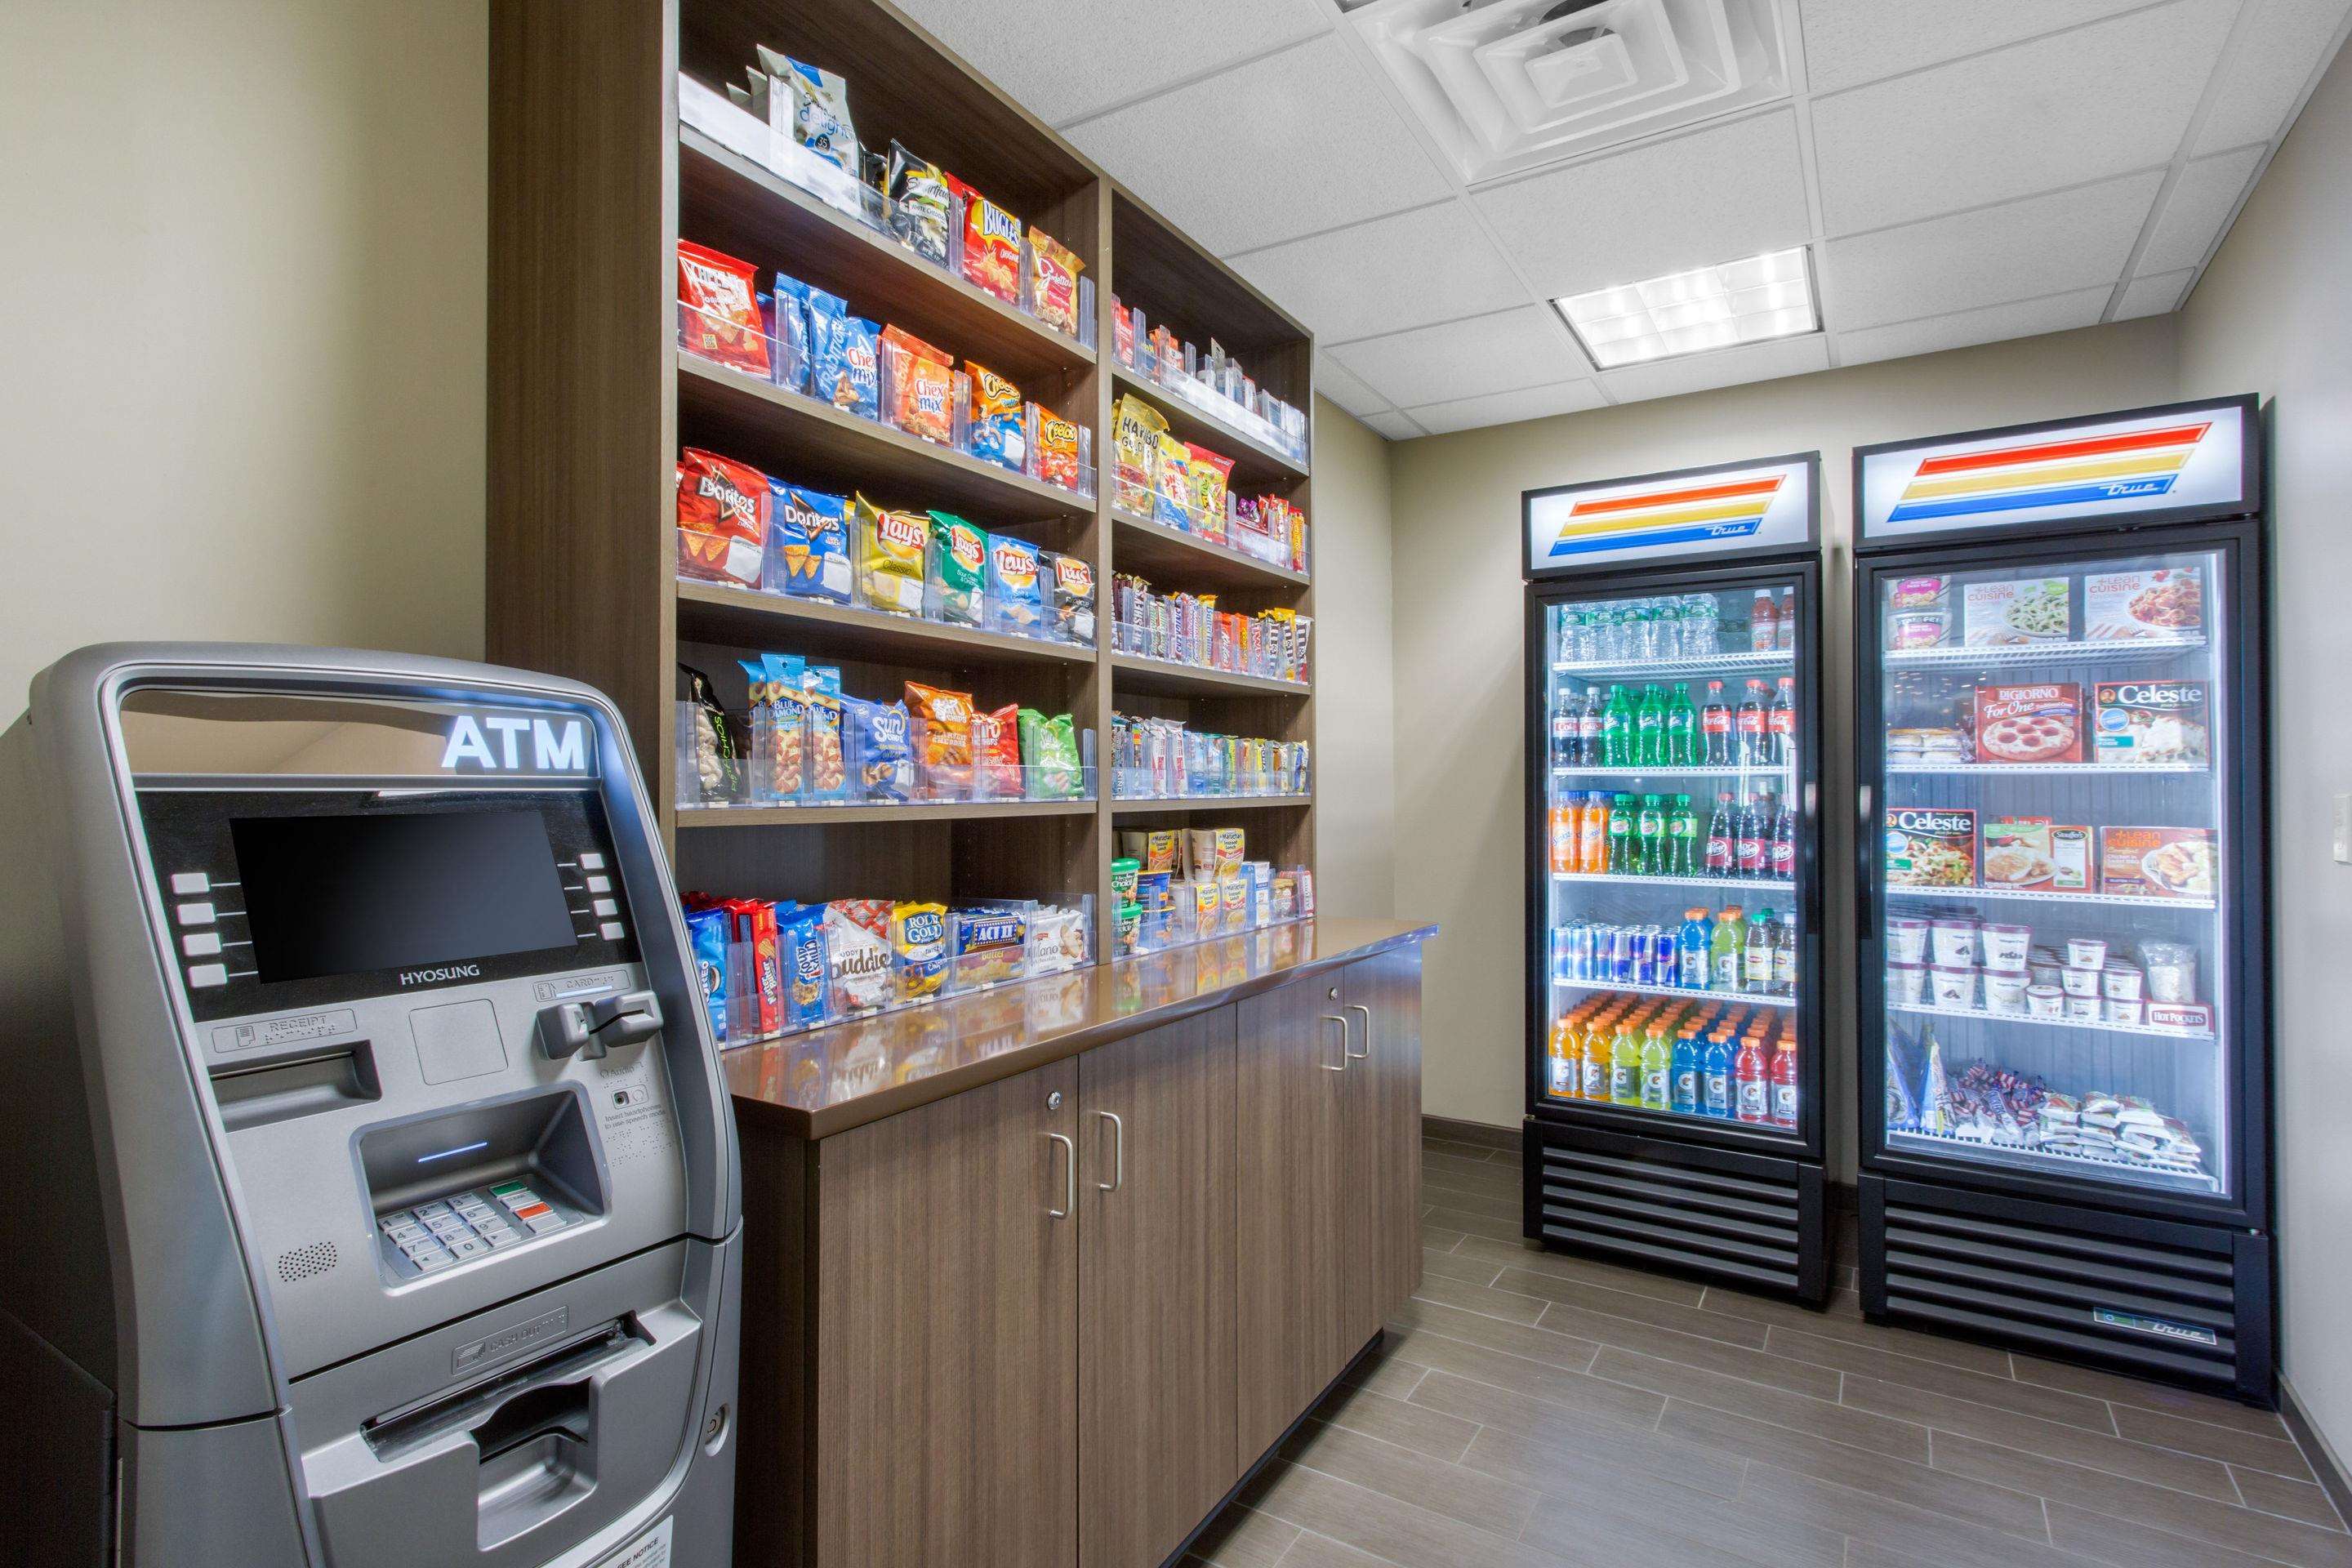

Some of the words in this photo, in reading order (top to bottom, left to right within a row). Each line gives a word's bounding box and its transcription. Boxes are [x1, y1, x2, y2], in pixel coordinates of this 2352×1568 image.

[817, 136, 828, 149] 35
[982, 198, 1020, 246] BUGLES
[915, 378, 943, 397] Chex
[699, 476, 756, 514] Doritos
[784, 504, 840, 532] Doritos
[880, 512, 924, 549] Lay's
[952, 533, 982, 561] Lay's
[882, 559, 912, 576] Classic
[996, 550, 1036, 576] Lay's
[2118, 684, 2203, 704] Celeste
[774, 700, 795, 710] BLUE
[1984, 703, 2007, 719] For
[2007, 701, 2034, 715] One
[872, 716, 906, 743] Sun
[441, 715, 585, 769] ATM
[1899, 811, 1971, 831] Celeste
[909, 914, 939, 928] ROLD
[907, 924, 943, 943] GOLD
[977, 926, 1000, 942] ACT
[399, 964, 480, 986] HYOSUNG
[270, 1015, 327, 1032] RECEIPT
[2154, 1012, 2170, 1022] HOT
[2169, 1013, 2204, 1022] POCKETS
[610, 1065, 635, 1078] Audio
[604, 1112, 623, 1122] Insert
[633, 1536, 660, 1561] NOTICE
